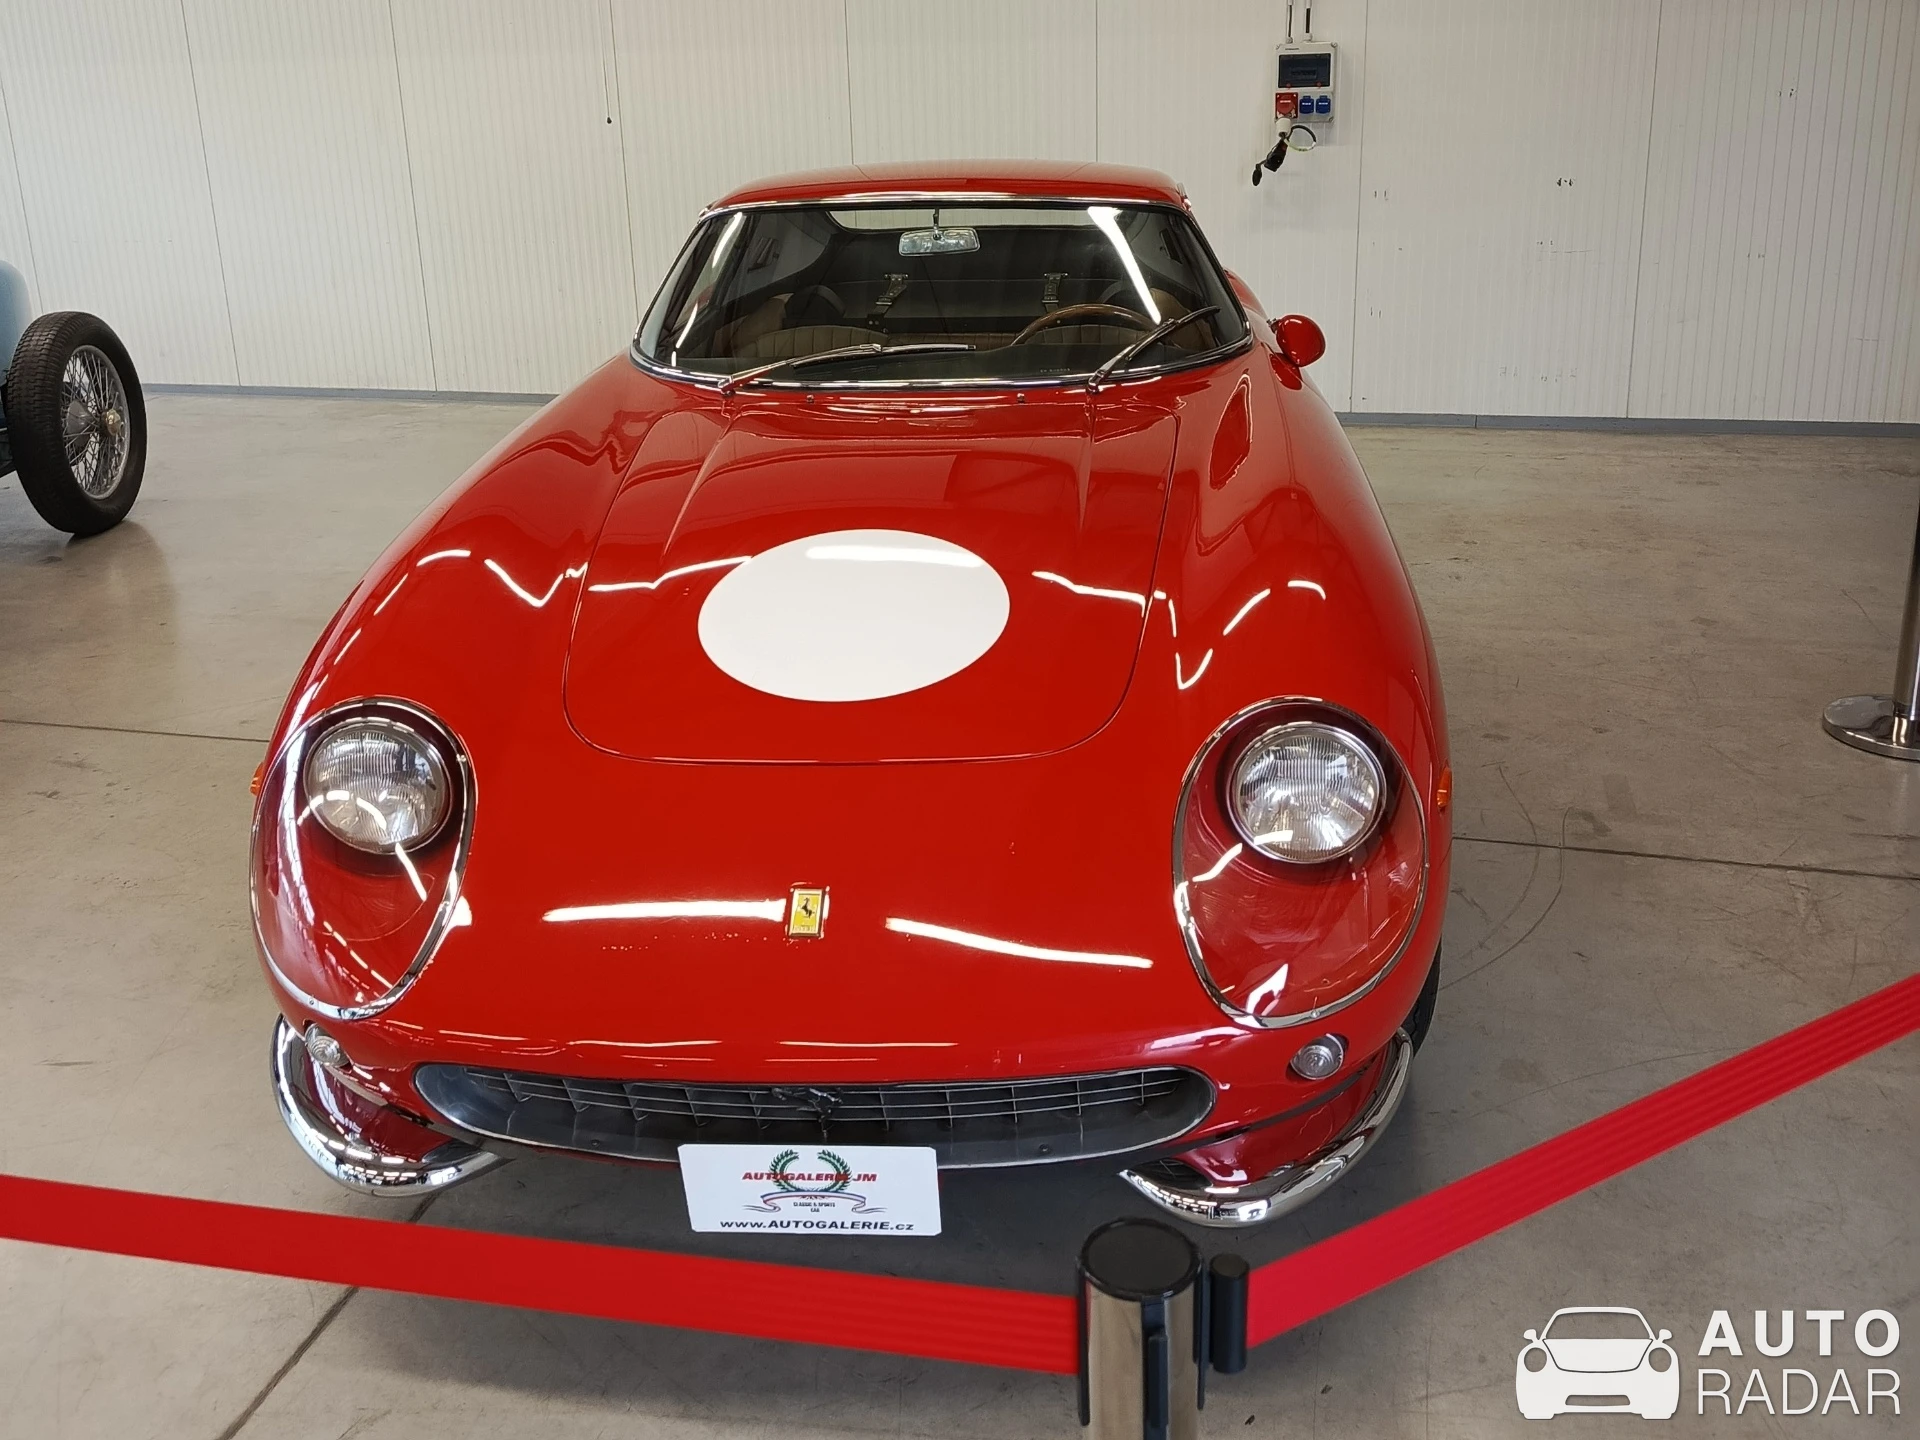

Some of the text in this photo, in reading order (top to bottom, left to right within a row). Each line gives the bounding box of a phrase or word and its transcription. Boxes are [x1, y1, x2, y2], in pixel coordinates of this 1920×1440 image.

[742, 1172, 878, 1182] AUTOGALERIE JM
[719, 1219, 915, 1231] www.AUTOGALERIE.cz
